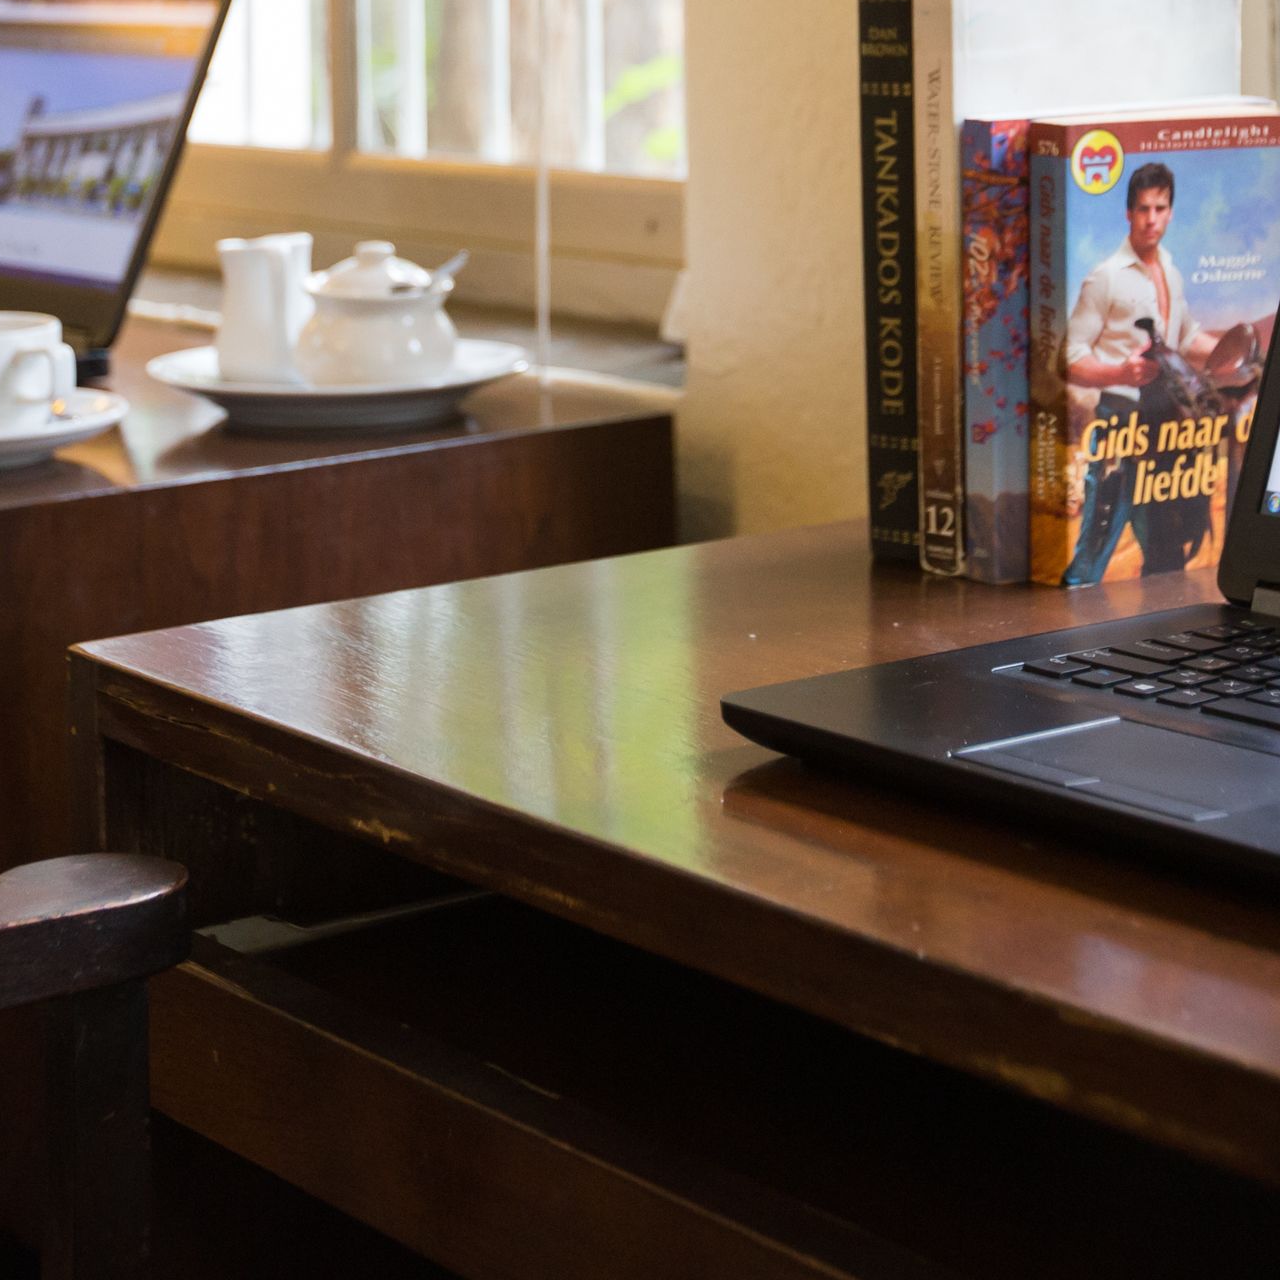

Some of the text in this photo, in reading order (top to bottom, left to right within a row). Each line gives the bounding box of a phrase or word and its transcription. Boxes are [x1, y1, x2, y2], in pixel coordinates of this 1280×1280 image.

[861, 43, 909, 58] BROWN
[868, 27, 898, 41] DAN
[1038, 138, 1060, 156] 576
[1157, 124, 1270, 142] Candlelight
[874, 111, 905, 416] TANKADOS KODE
[928, 225, 944, 303] REVIEW
[1039, 223, 1055, 270] naar
[1081, 410, 1150, 462] Gids
[1157, 414, 1230, 453] naar
[1132, 451, 1218, 506] liefde
[926, 505, 956, 538] 12
